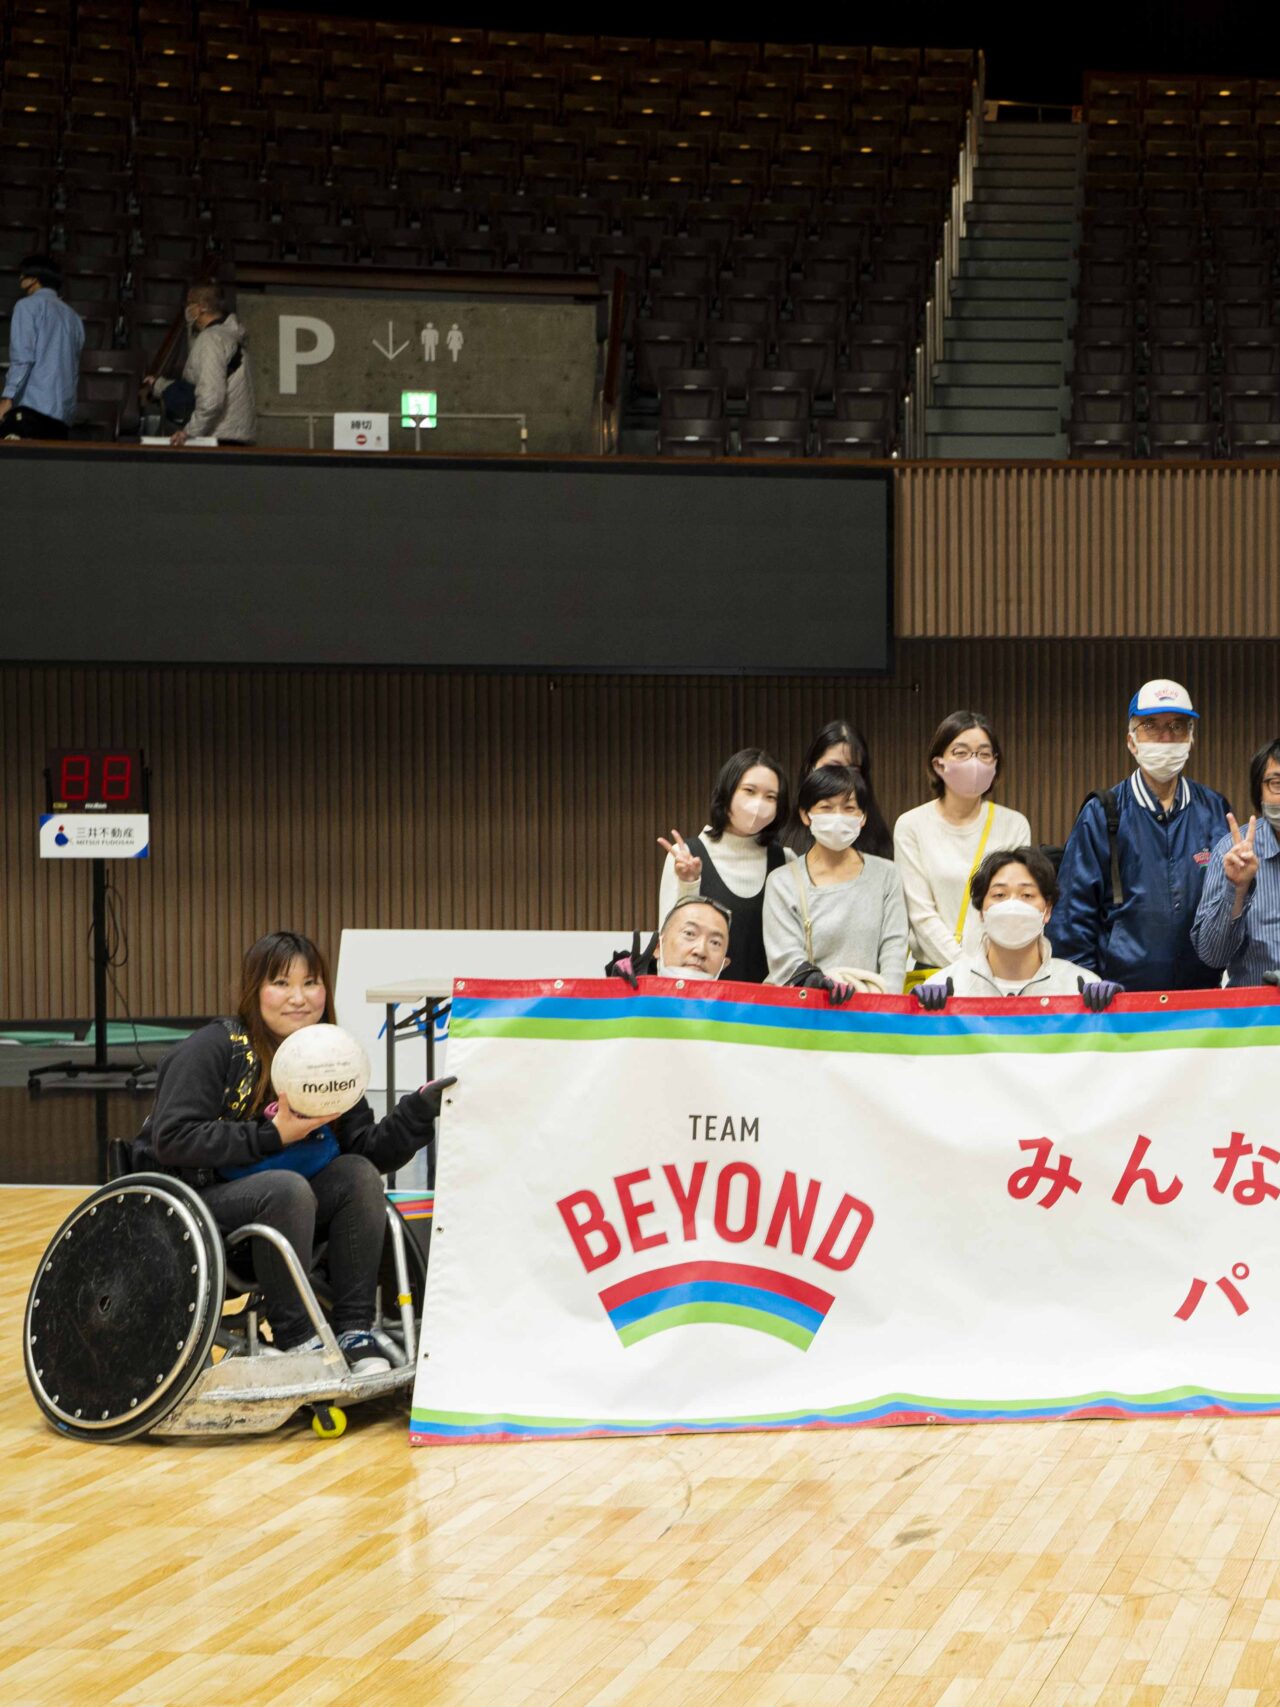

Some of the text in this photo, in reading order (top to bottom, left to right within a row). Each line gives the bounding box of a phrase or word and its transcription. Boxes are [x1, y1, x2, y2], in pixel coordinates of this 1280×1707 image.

[279, 315, 335, 394] P
[76, 827, 134, 839] 三井不動産
[302, 1079, 357, 1093] molten
[688, 1114, 761, 1143] TEAM
[556, 1161, 875, 1274] BEYOND
